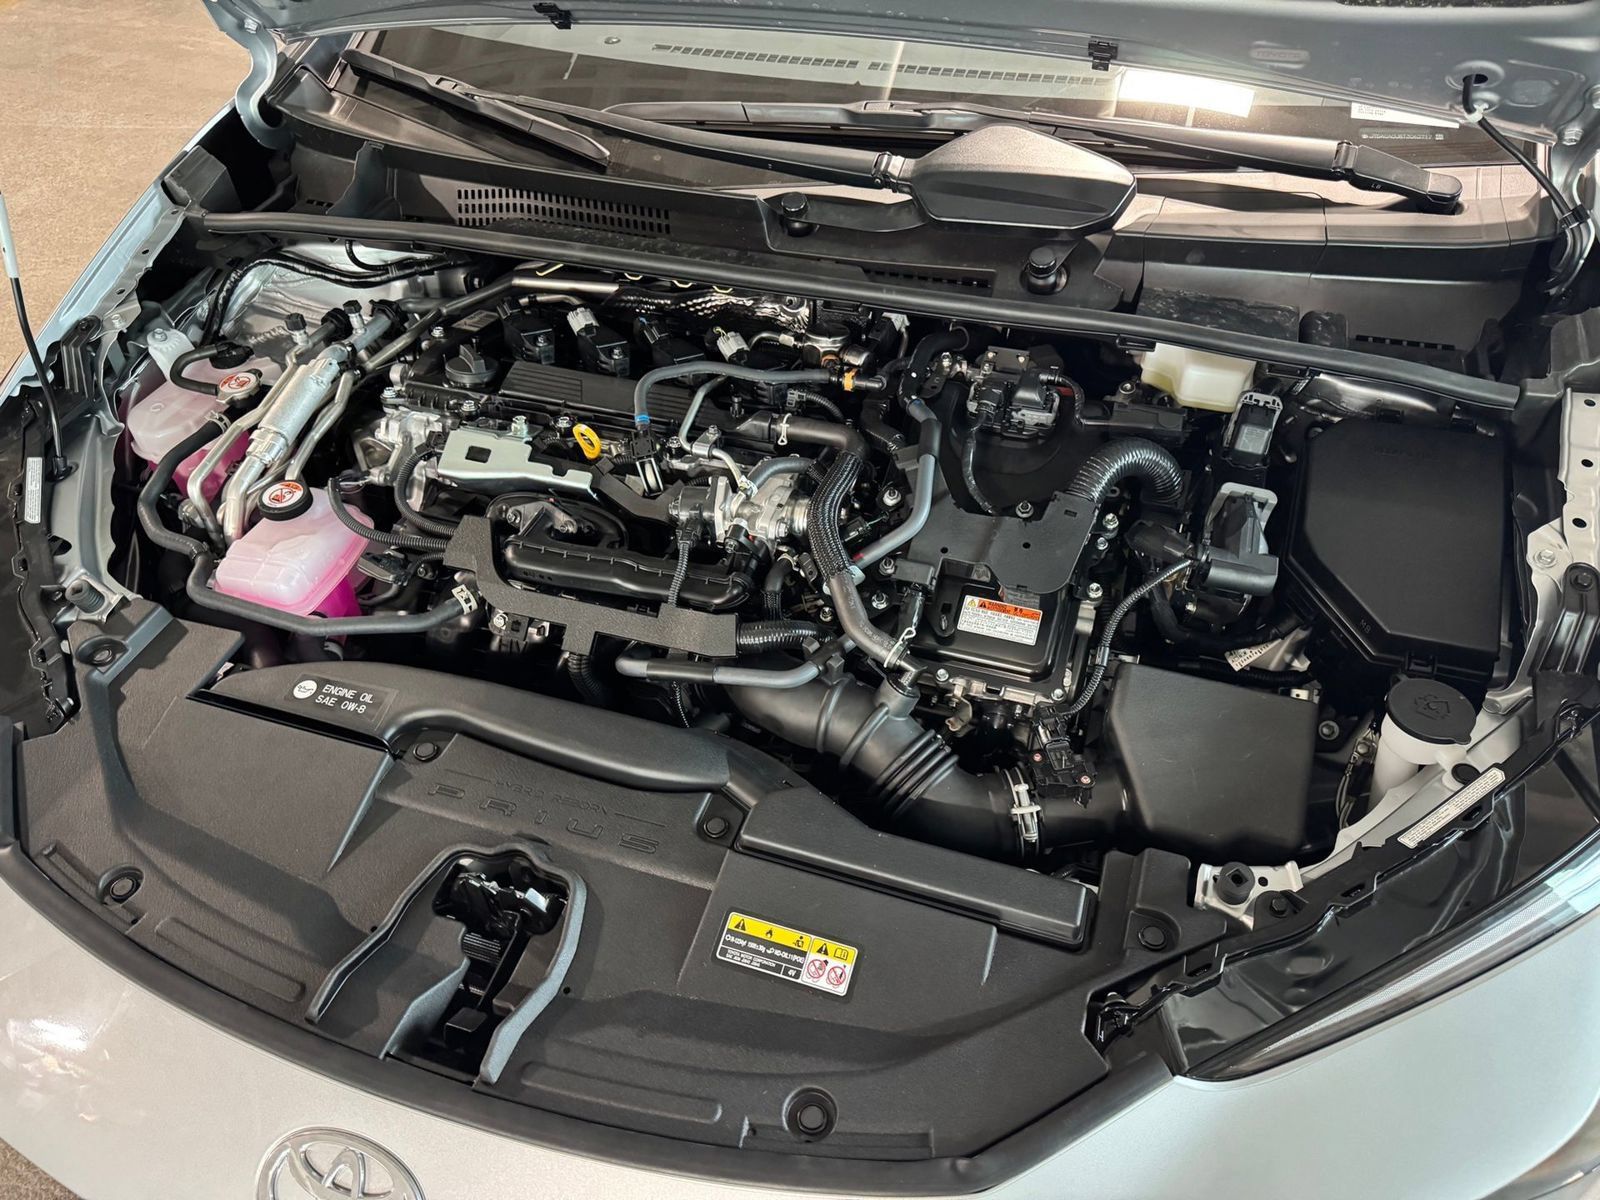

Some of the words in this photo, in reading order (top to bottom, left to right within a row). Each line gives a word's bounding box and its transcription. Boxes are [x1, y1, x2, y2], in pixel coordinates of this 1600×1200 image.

[315, 694, 338, 707] SAE
[322, 684, 357, 699] ENGINE
[359, 692, 374, 704] OIL
[427, 783, 660, 854] PRIUS
